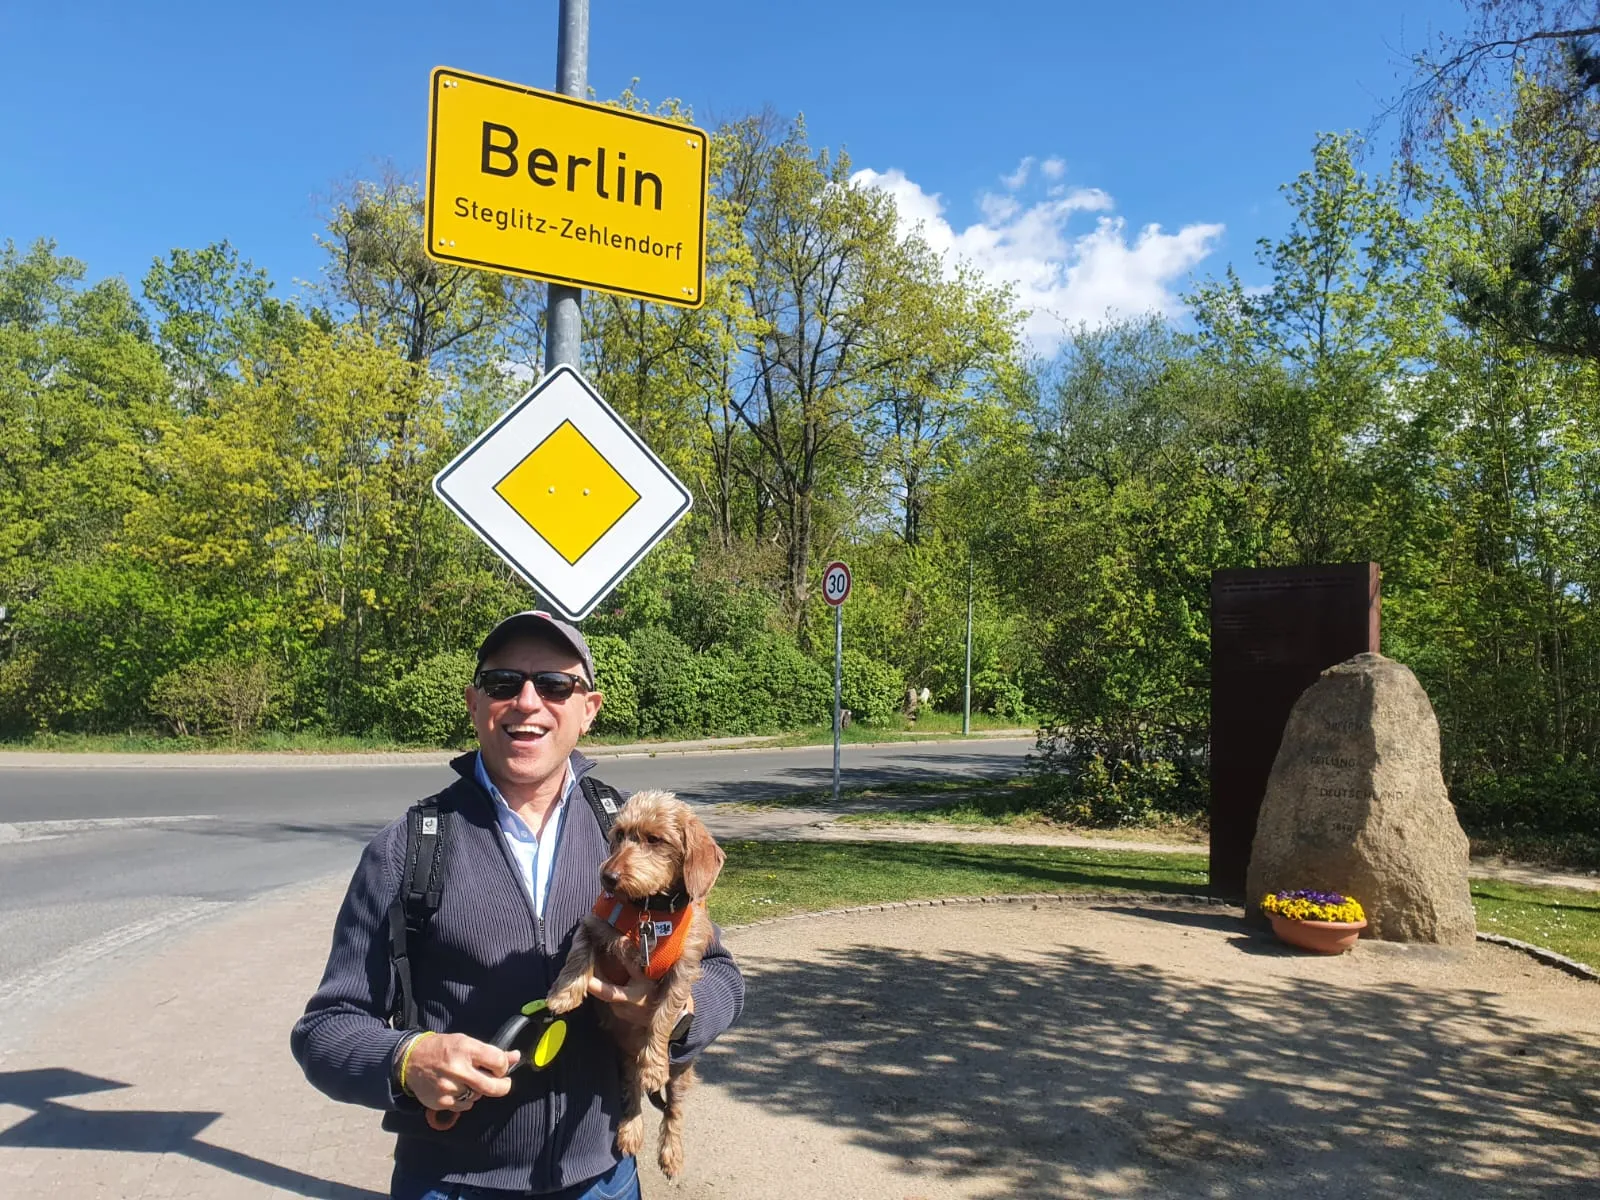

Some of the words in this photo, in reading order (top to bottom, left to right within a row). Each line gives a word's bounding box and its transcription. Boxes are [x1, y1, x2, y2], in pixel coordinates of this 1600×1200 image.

[481, 121, 662, 210] Berlin
[454, 197, 683, 260] Steglitz-Zehlendorf
[828, 573, 845, 594] 30
